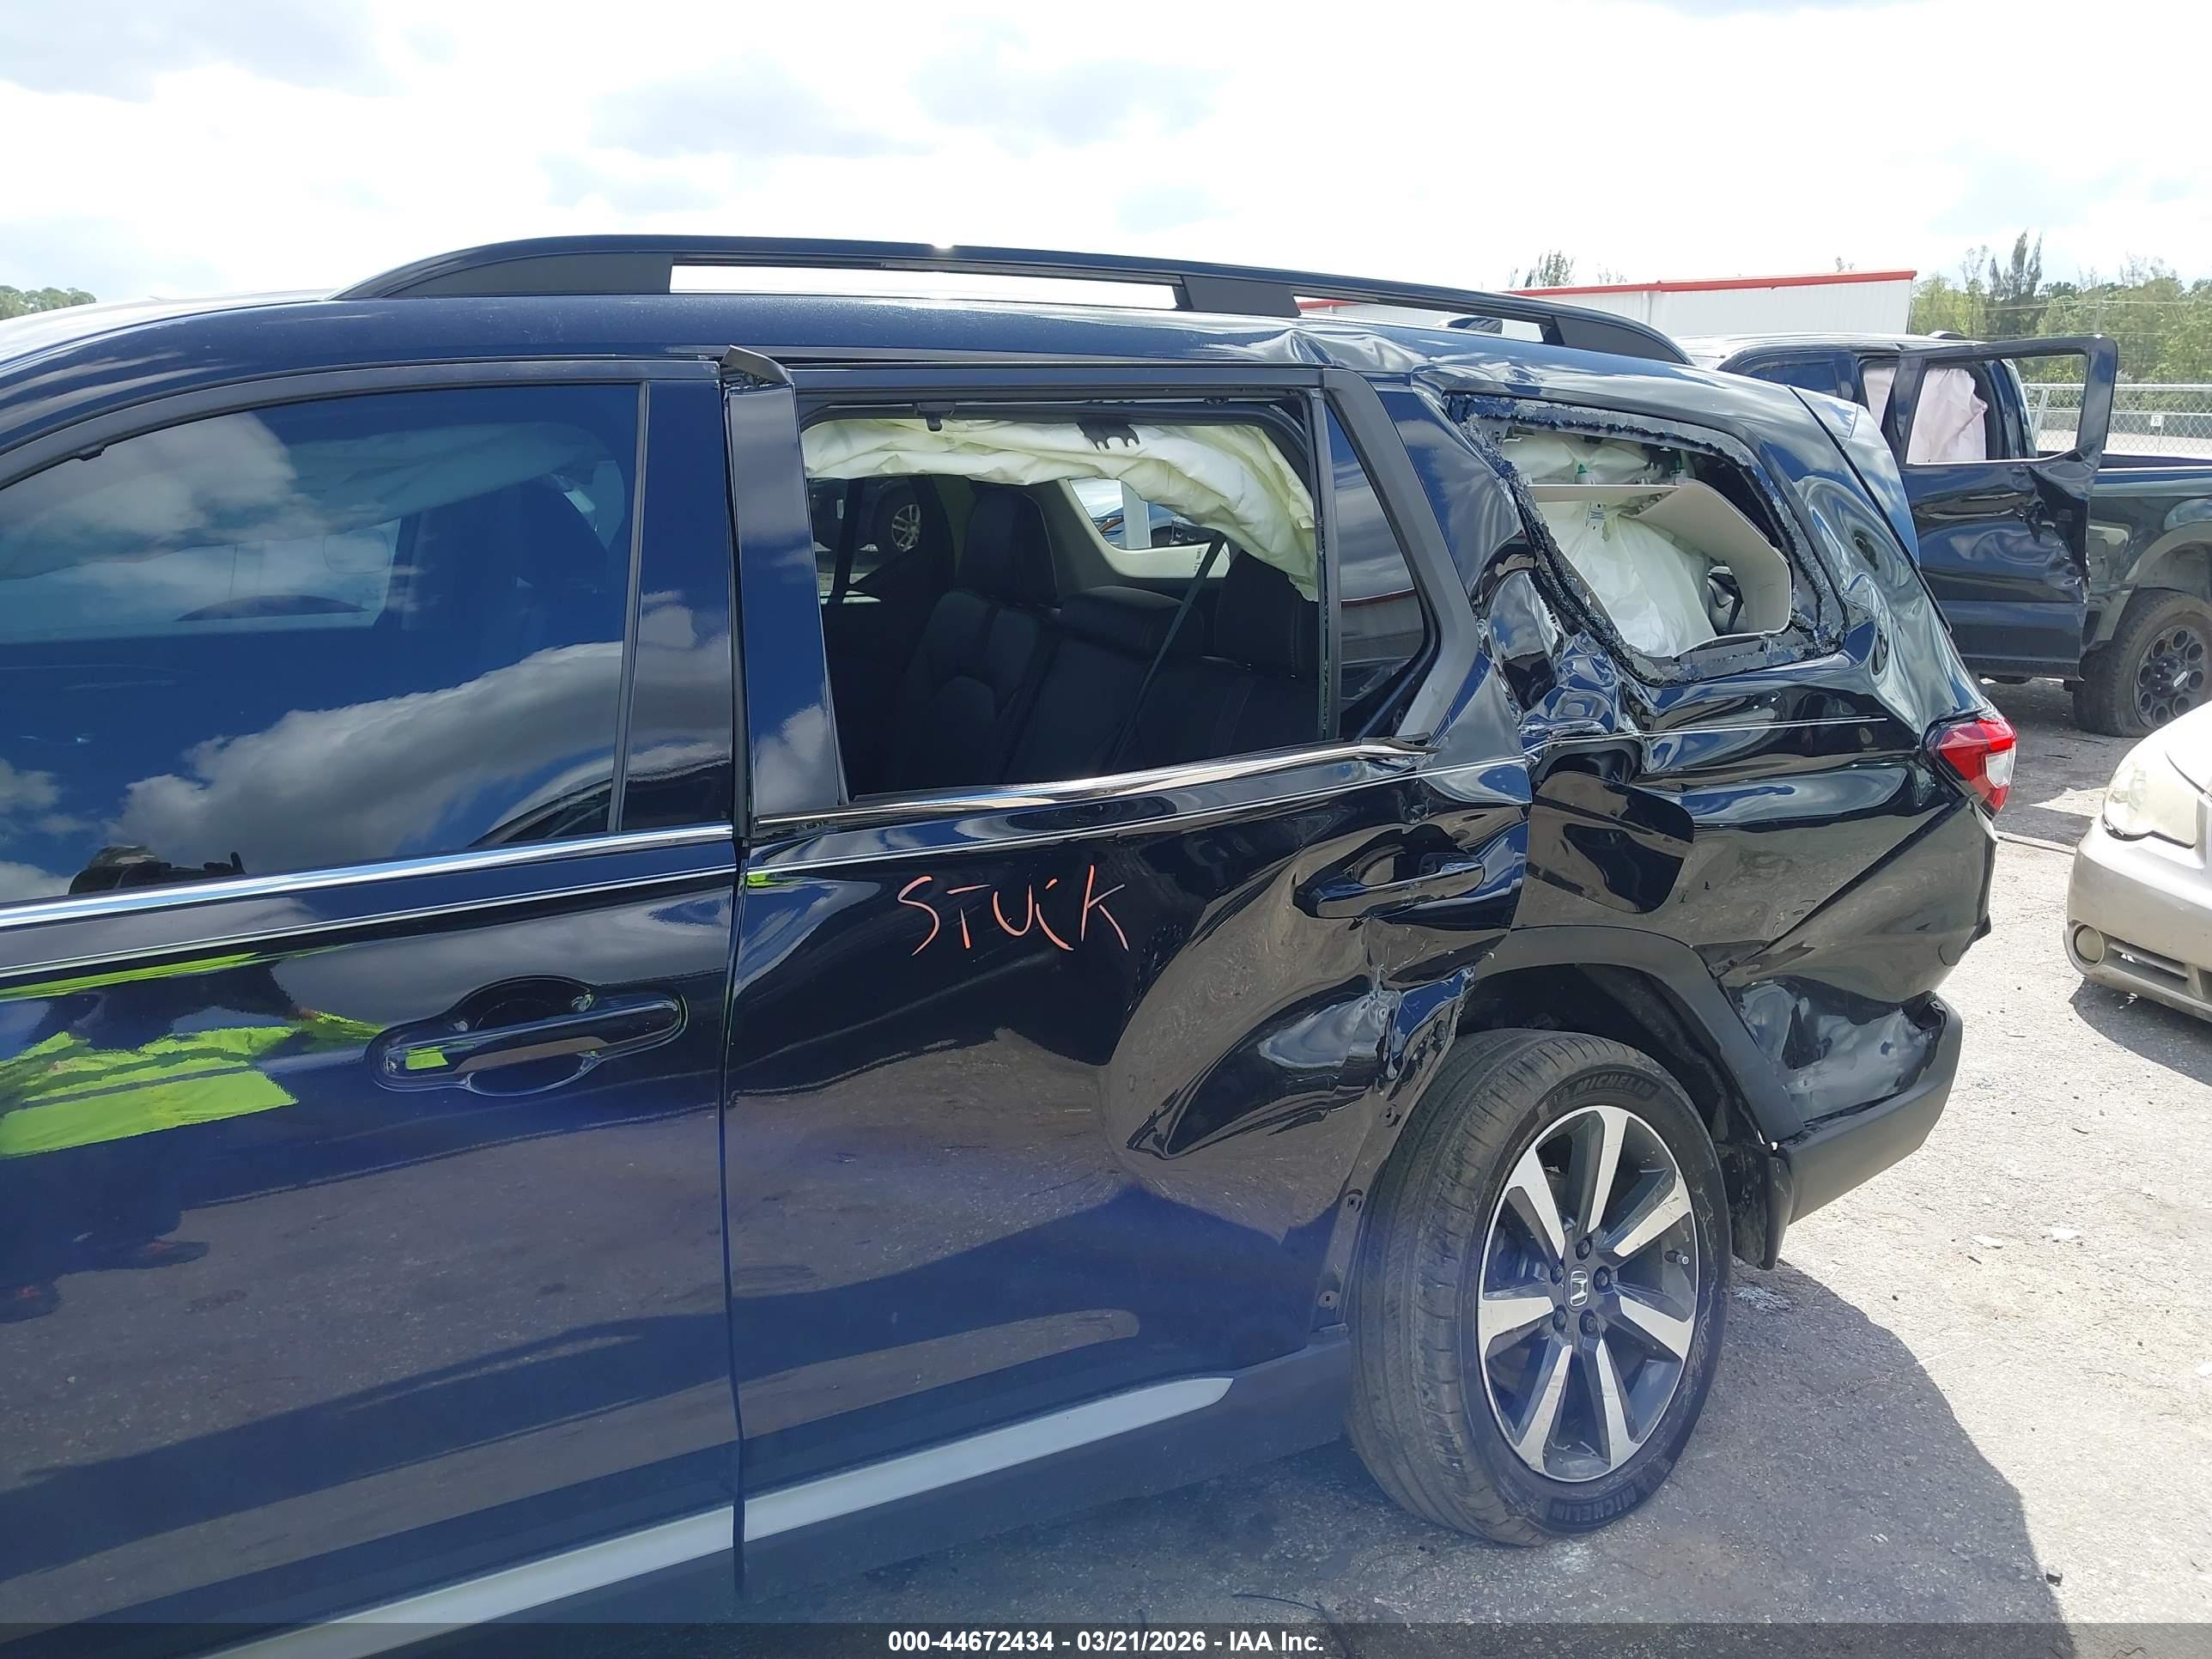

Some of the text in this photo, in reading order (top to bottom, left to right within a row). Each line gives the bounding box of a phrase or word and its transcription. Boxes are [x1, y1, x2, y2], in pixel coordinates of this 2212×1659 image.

[897, 865, 1129, 956] STUCK
[1573, 1074, 1656, 1097] MICHELIN
[1552, 1486, 1637, 1521] MICHELIN
